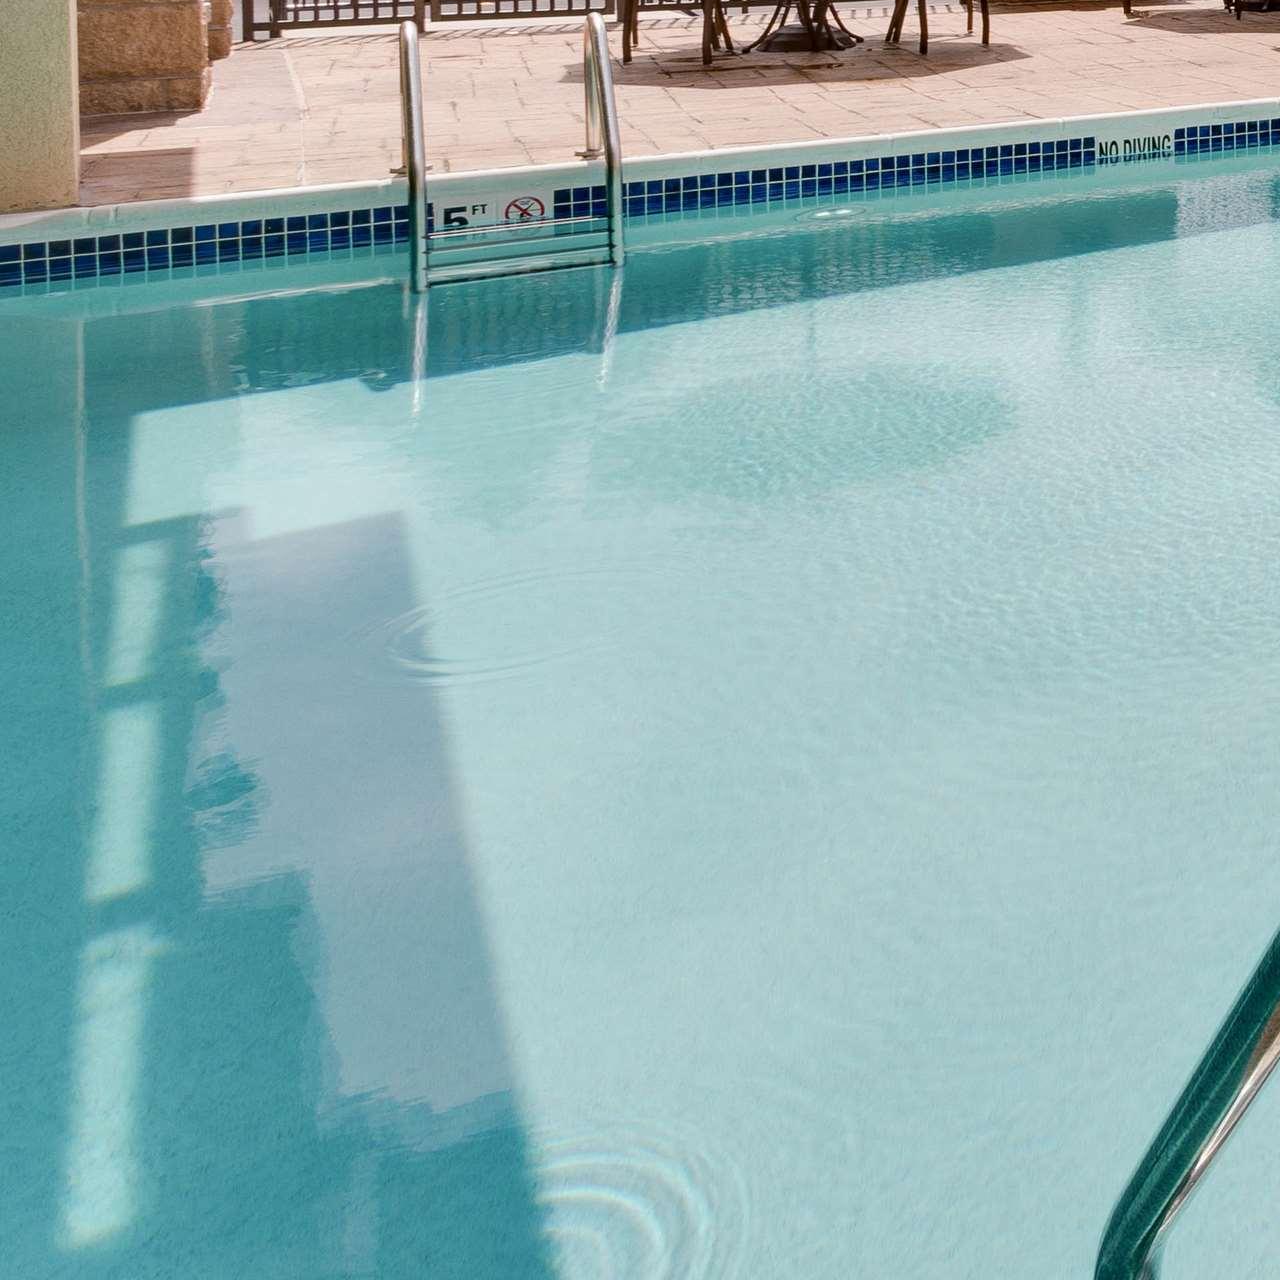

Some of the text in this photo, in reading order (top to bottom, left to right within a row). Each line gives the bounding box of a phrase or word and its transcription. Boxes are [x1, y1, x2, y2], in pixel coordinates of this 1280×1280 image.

[1099, 134, 1171, 158] NO DIVING
[443, 203, 488, 228] 5 FT
